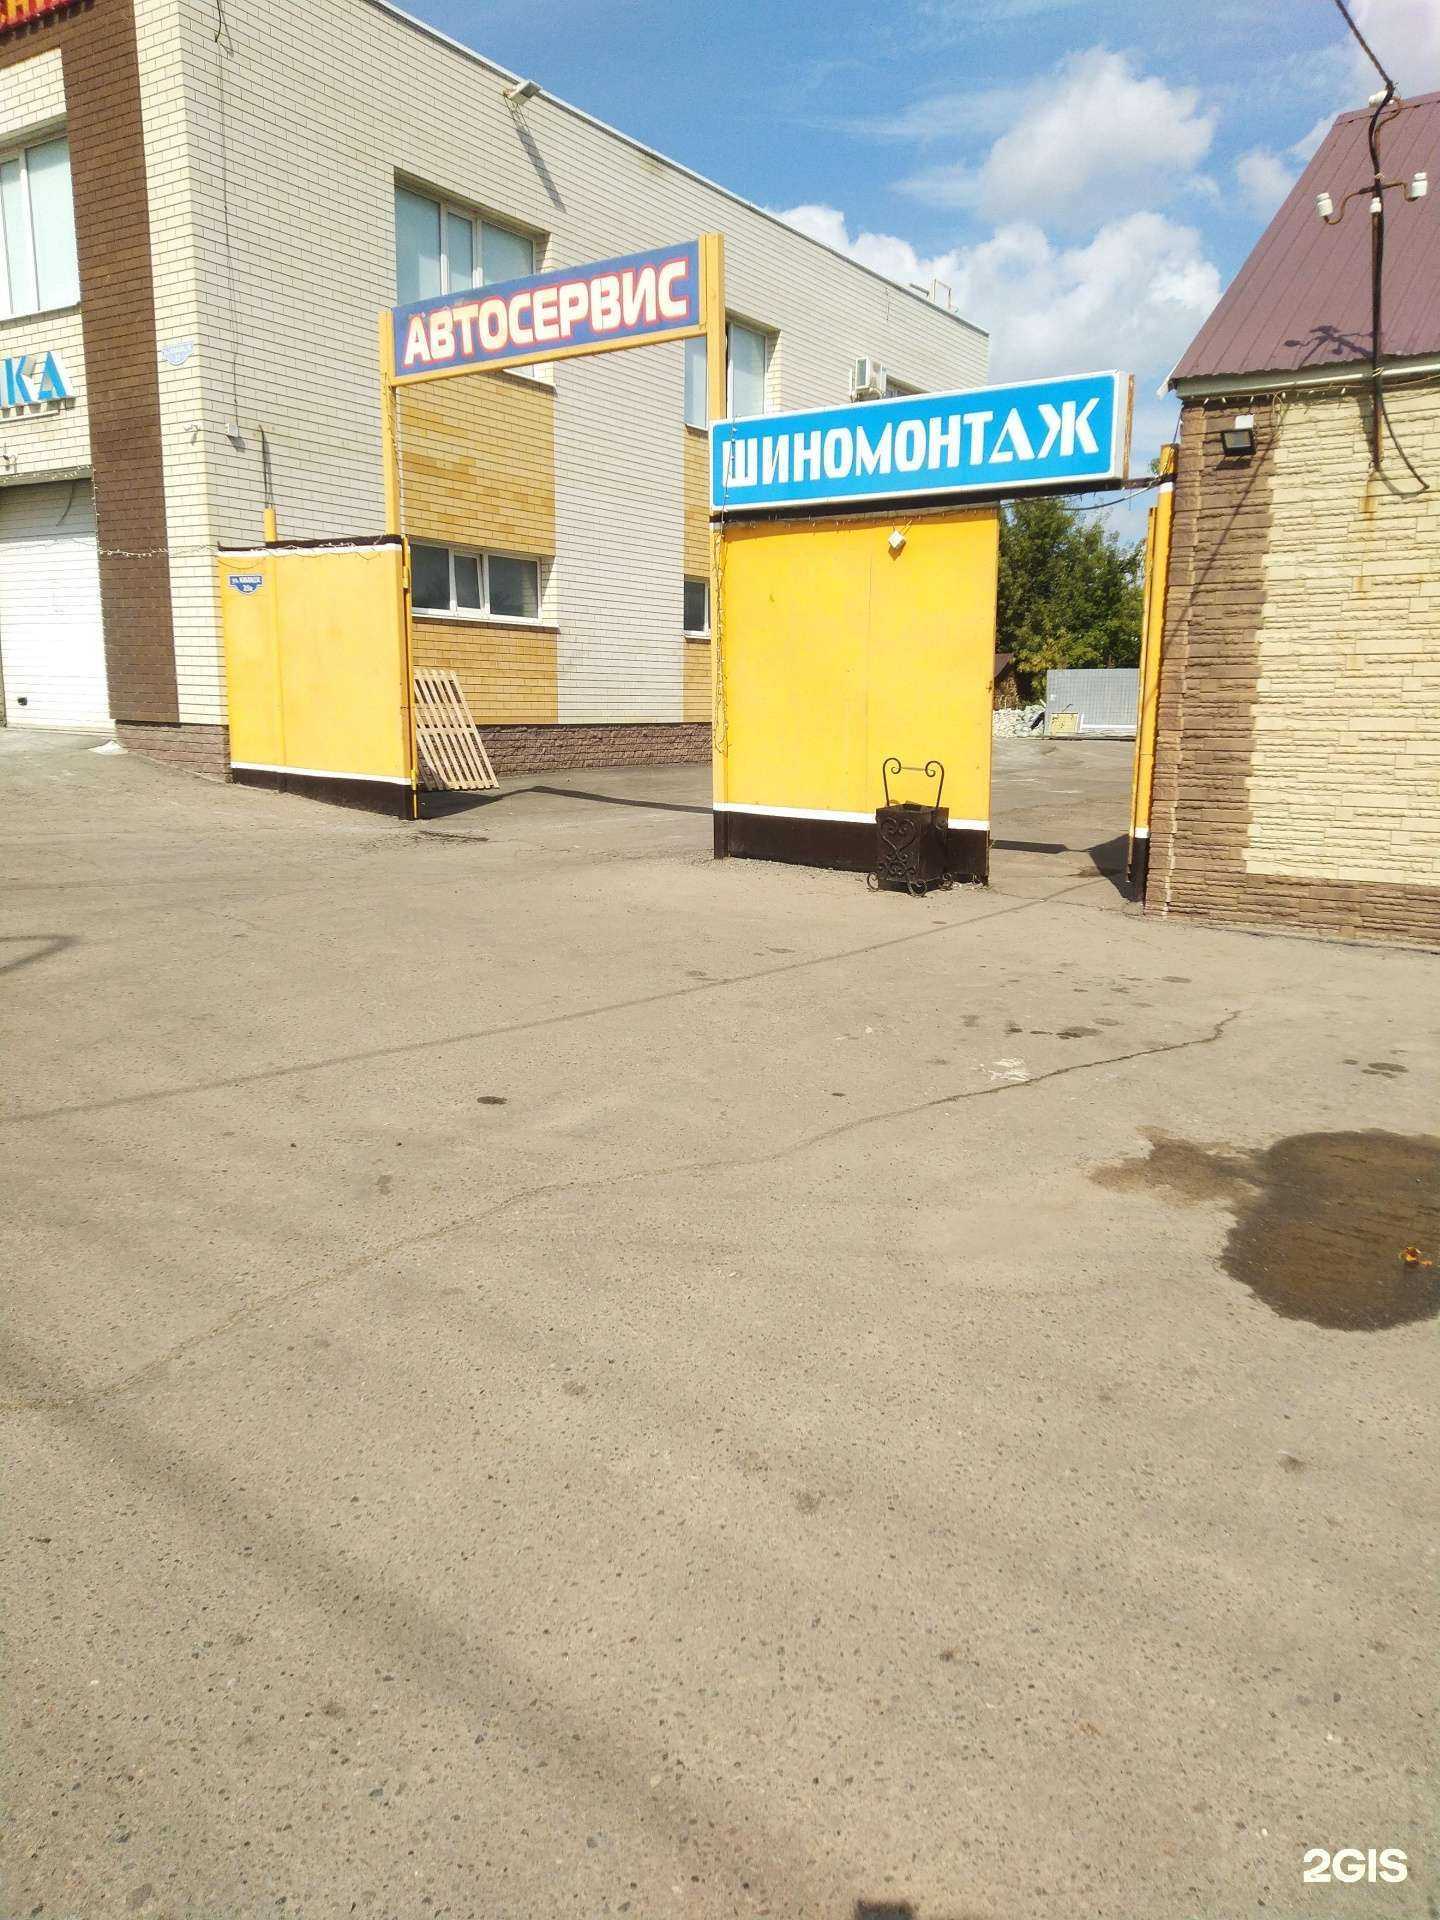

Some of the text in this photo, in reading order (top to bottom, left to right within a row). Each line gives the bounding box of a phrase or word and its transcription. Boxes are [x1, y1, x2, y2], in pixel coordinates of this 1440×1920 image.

[402, 258, 690, 366] АВТОСЕРВИС
[0, 351, 67, 408] КА
[721, 397, 1101, 488] ШИНОМОНТАЖ
